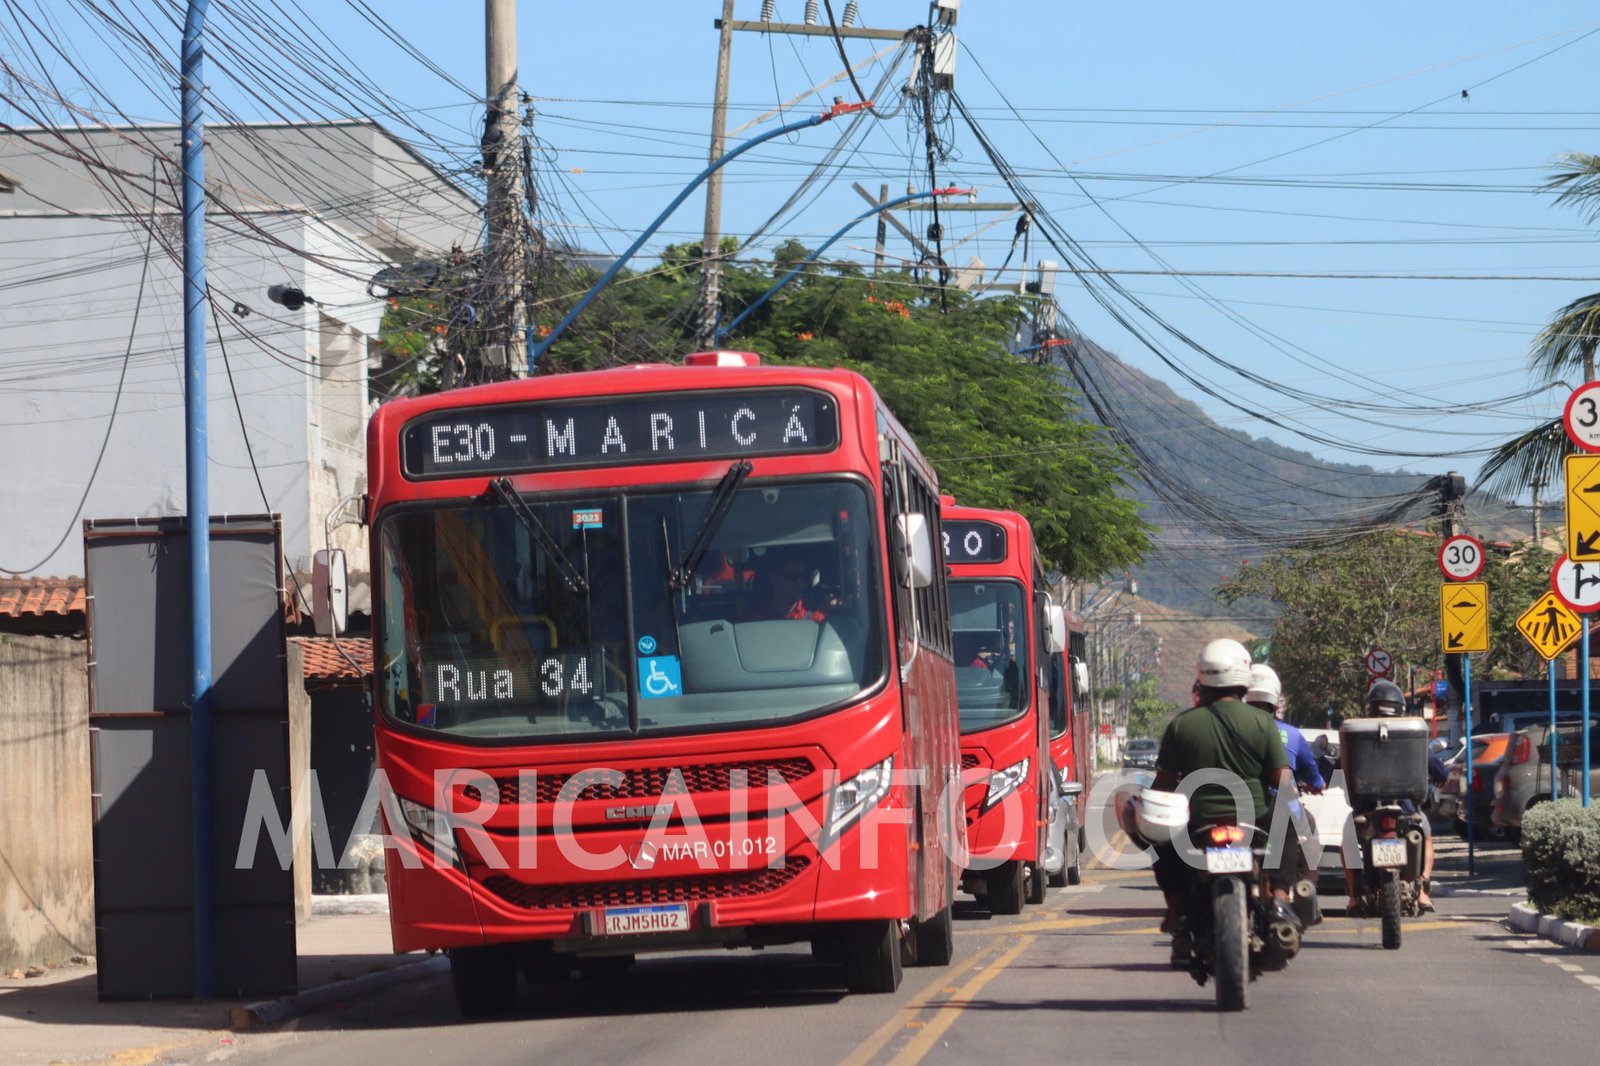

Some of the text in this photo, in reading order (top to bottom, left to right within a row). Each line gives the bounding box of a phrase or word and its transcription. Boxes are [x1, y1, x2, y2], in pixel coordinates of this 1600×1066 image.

[432, 423, 495, 463] E30
[1448, 545, 1475, 565] 30
[437, 657, 593, 702] Rua 34
[663, 836, 777, 861] MAR 01.012
[612, 913, 679, 932] RJM5H02
